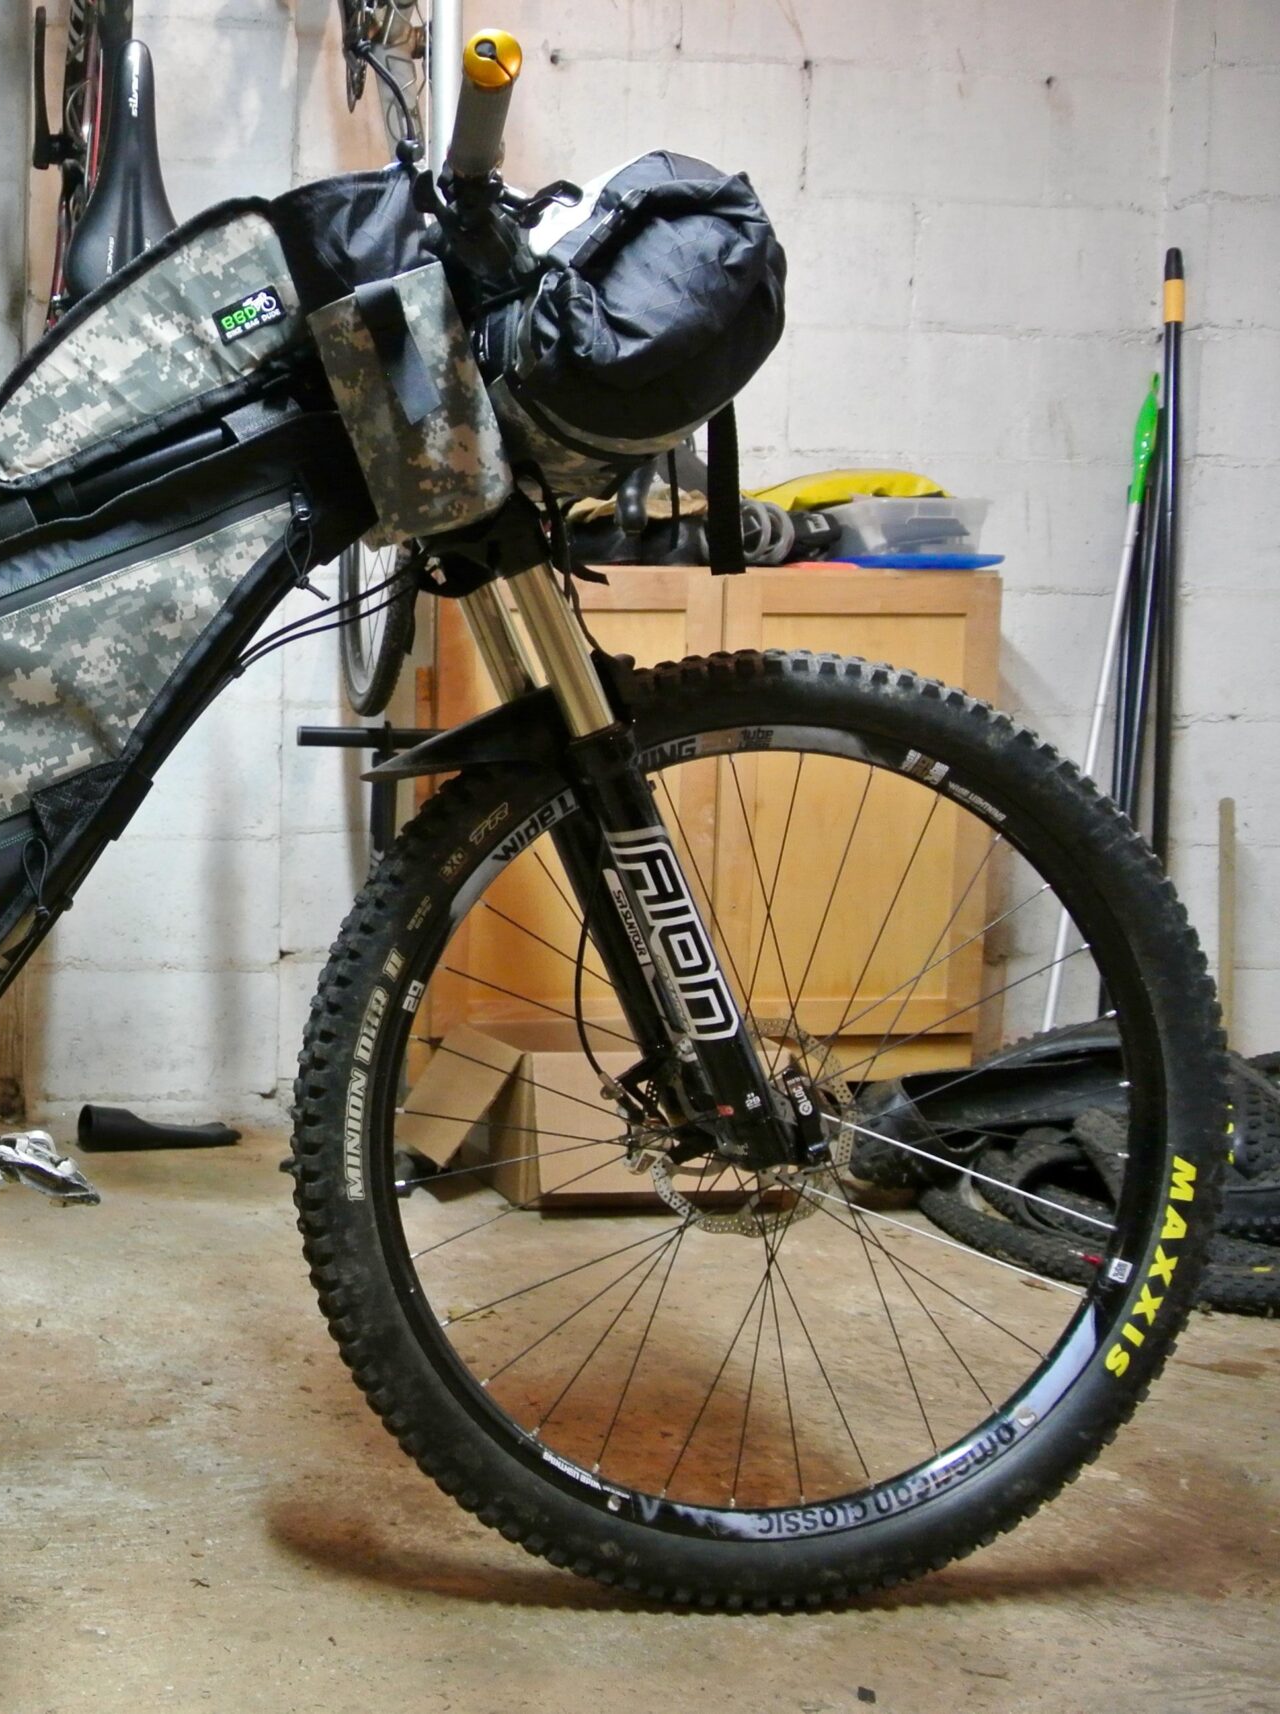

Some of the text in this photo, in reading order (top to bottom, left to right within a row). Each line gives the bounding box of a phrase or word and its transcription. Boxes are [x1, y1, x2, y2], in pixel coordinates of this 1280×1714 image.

[221, 306, 257, 330] BBD
[244, 318, 260, 330] BAG
[261, 308, 281, 322] DUDE
[470, 802, 508, 845] TR
[612, 889, 647, 957] SR SUNTOUR
[612, 842, 739, 1041] AION
[402, 979, 424, 1013] 29
[344, 948, 406, 1200] MINION DHR II
[1105, 1155, 1197, 1378] MAXXIS
